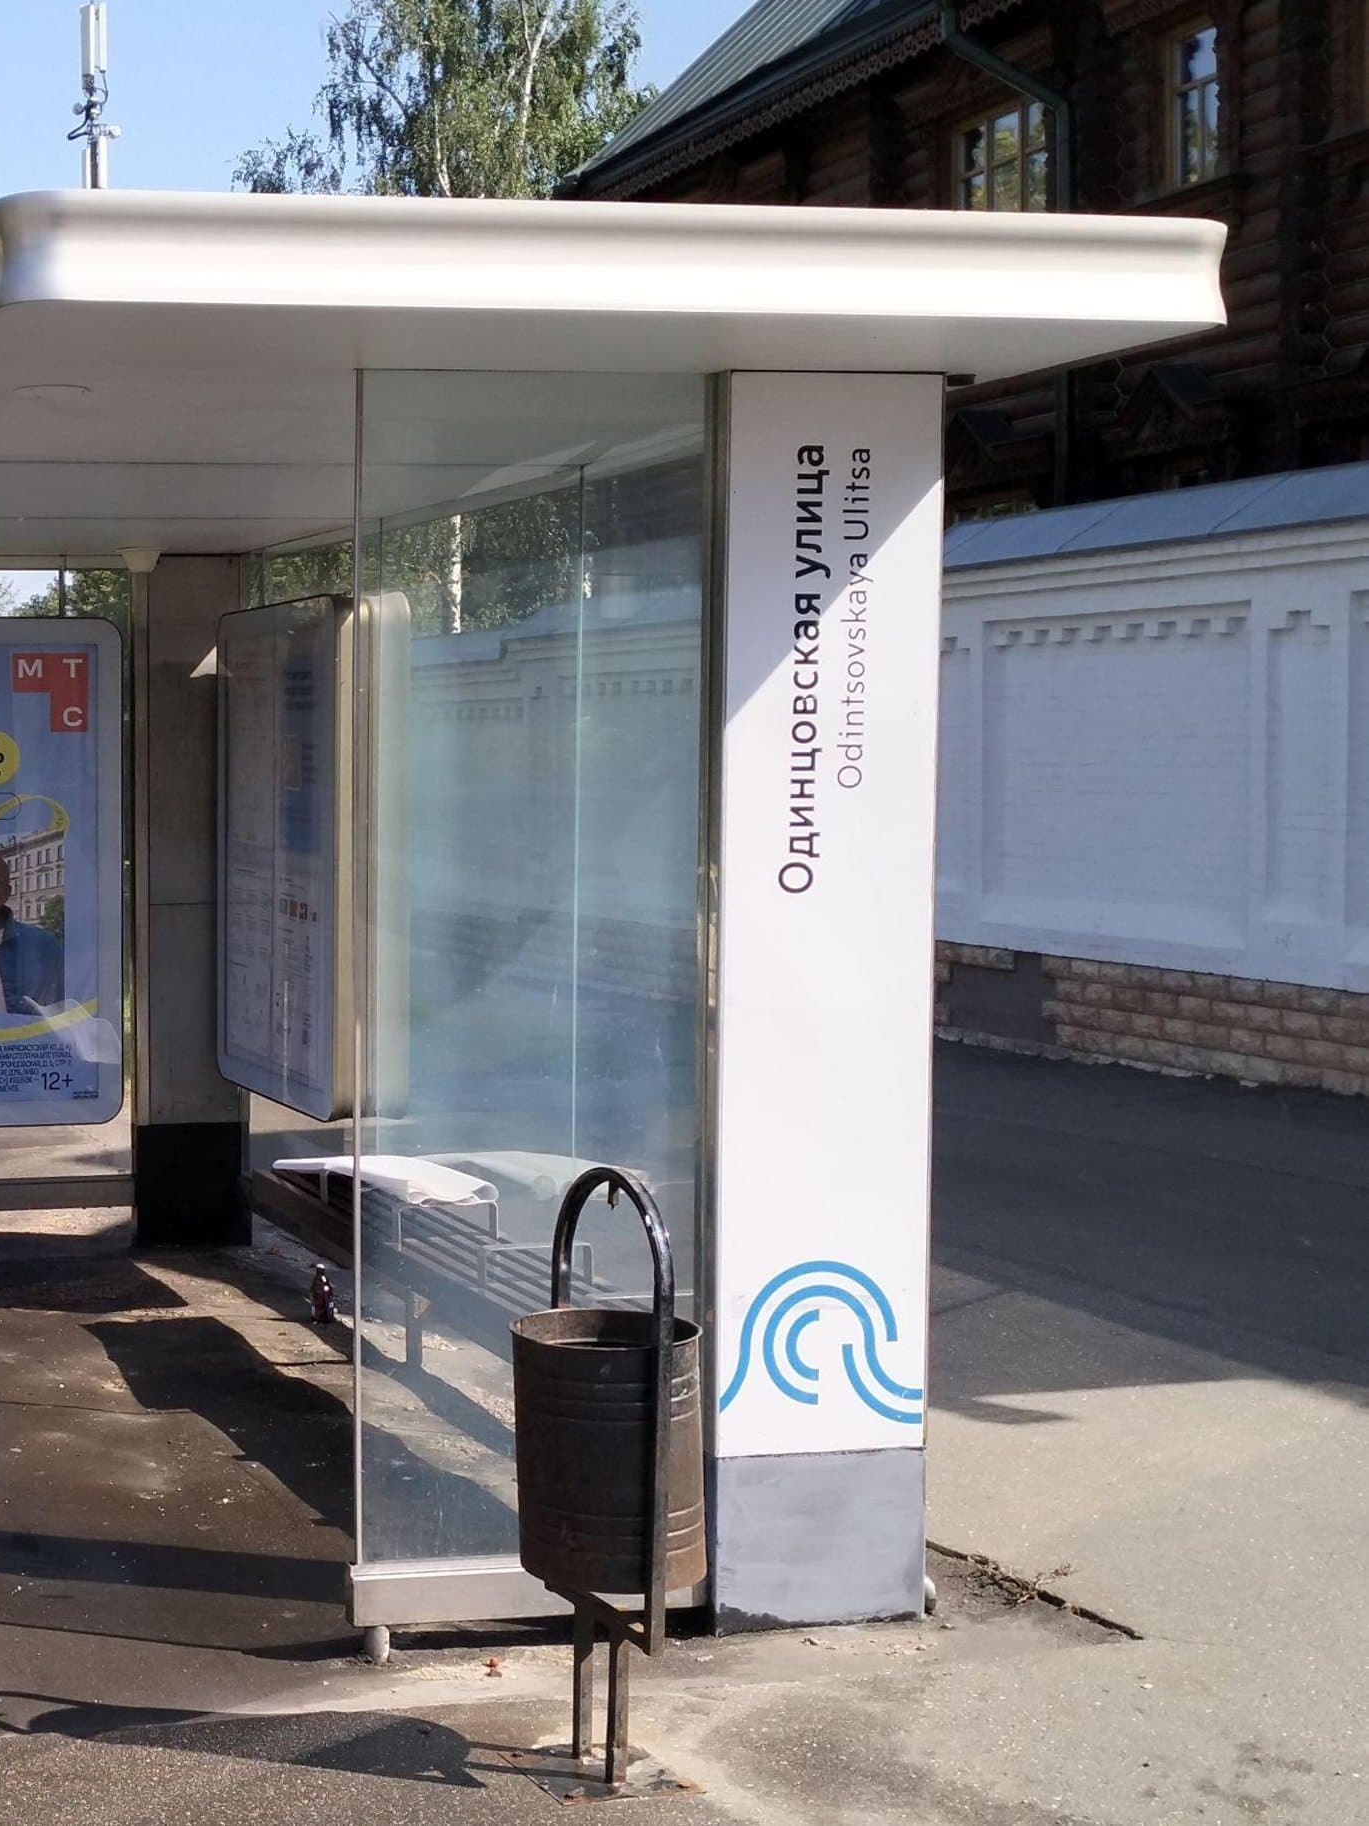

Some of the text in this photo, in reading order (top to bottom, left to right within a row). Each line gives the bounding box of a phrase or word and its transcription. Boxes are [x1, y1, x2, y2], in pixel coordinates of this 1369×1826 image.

[778, 444, 830, 893] Одинцовская улица
[836, 448, 874, 789] Odintsovskaya Ulitsa
[41, 1071, 74, 1090] 12+
